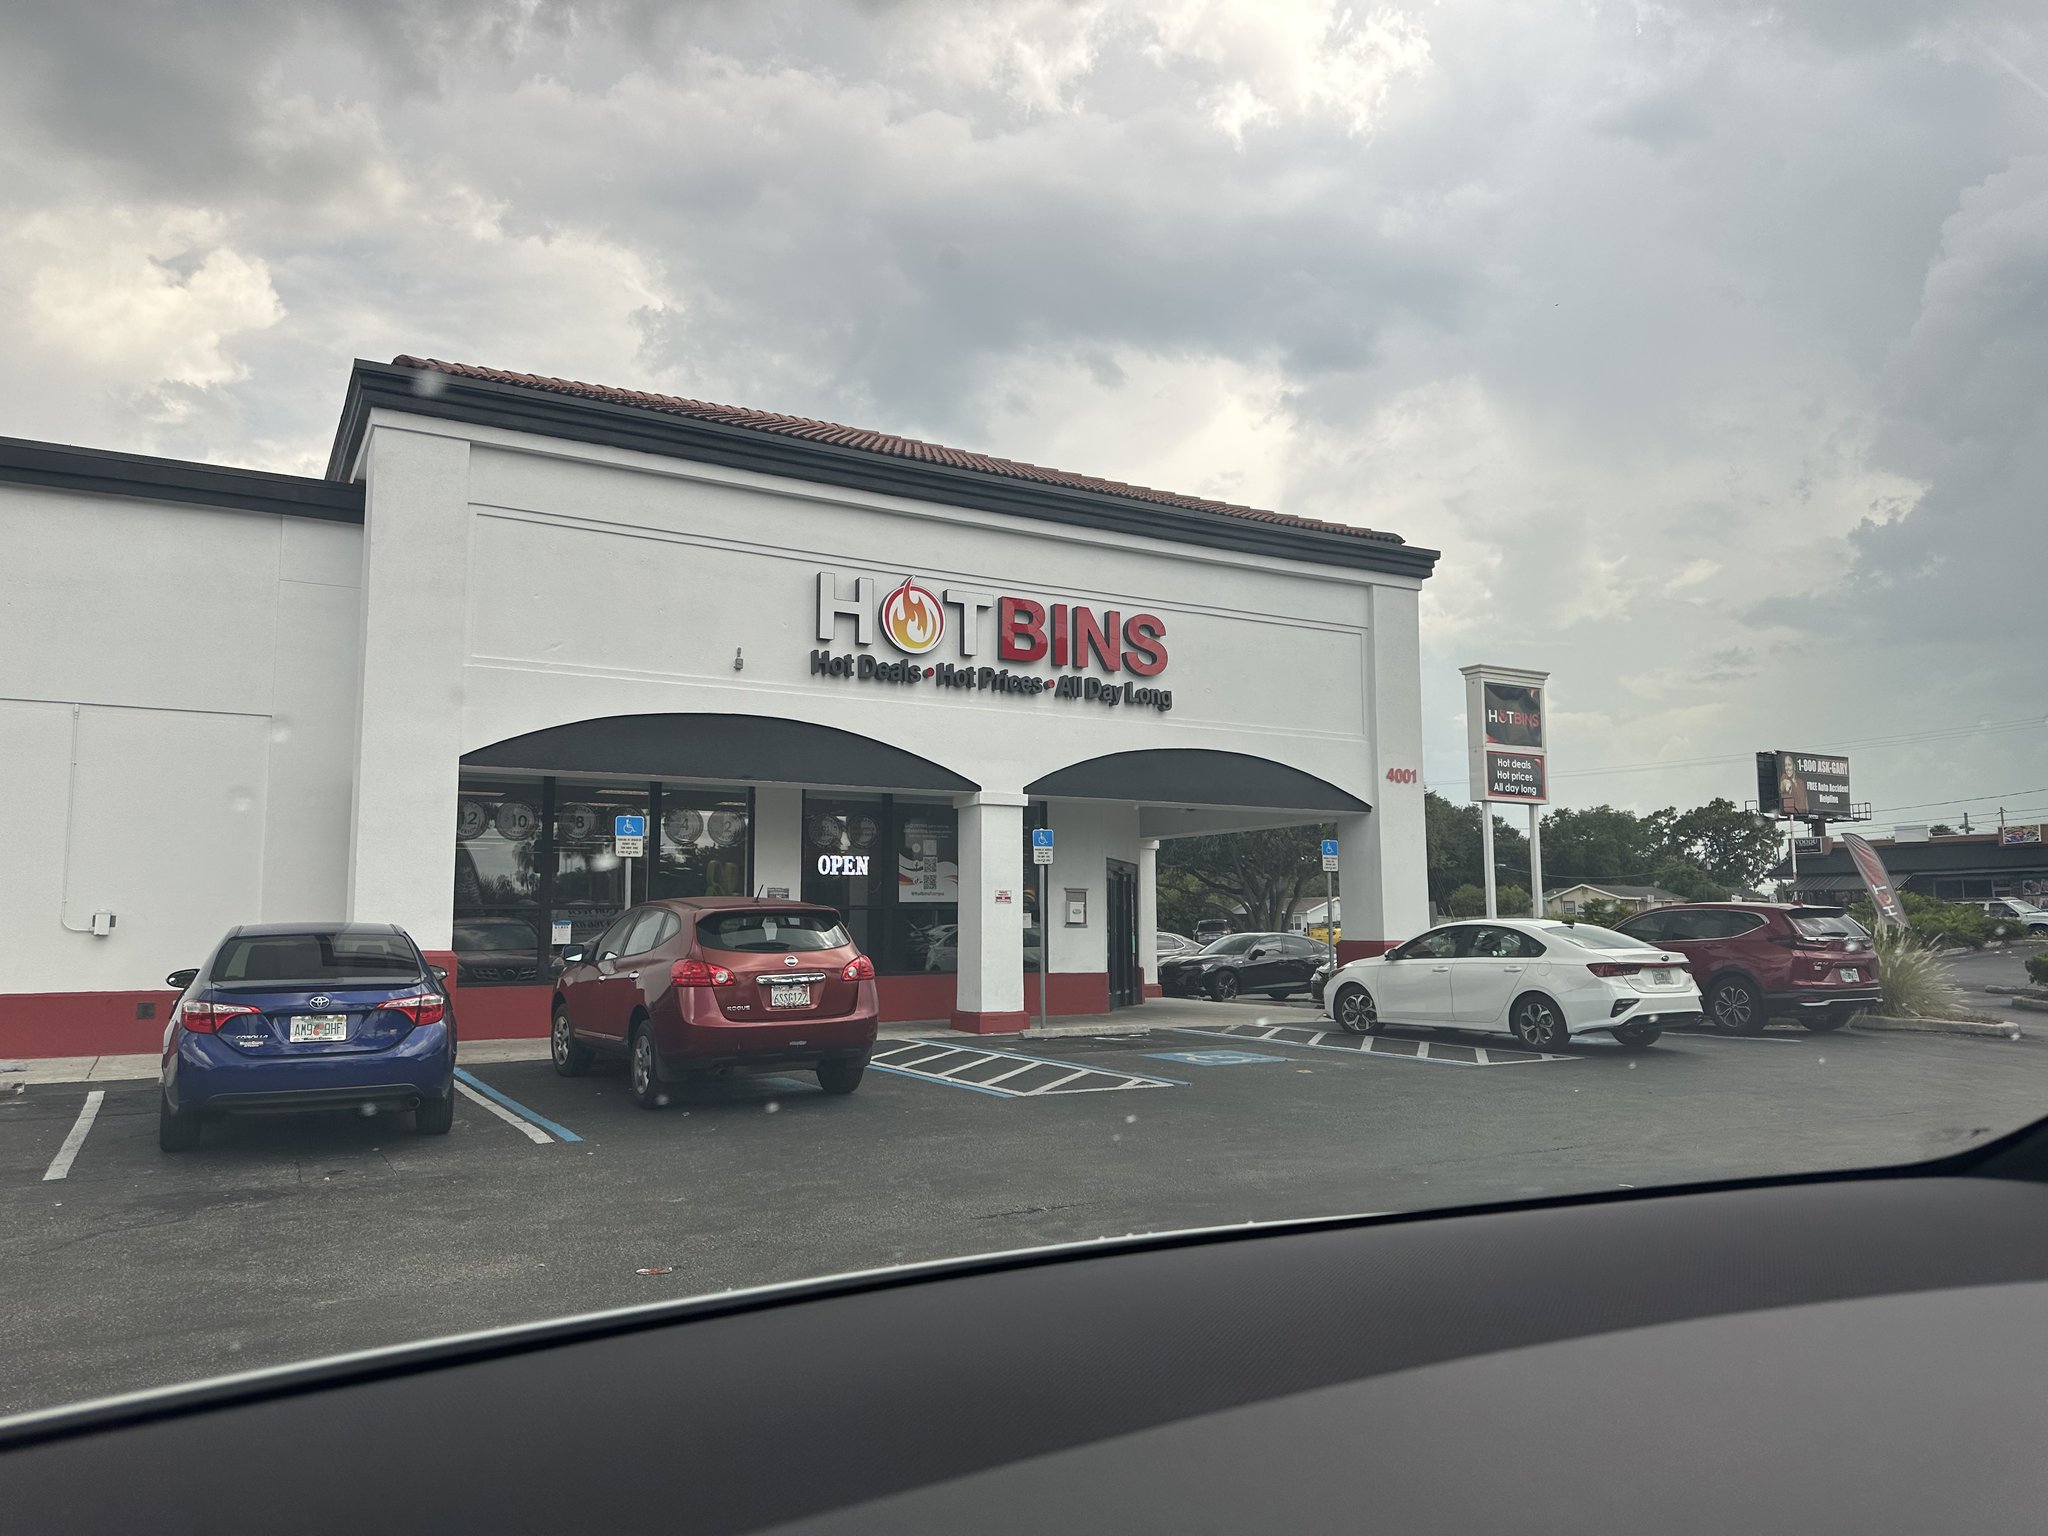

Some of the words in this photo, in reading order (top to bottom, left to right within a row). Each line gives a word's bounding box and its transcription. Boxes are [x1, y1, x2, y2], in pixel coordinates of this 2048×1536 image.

[810, 650, 854, 677] Hot
[857, 654, 921, 683] Deals
[935, 662, 976, 689] Hot
[978, 667, 1043, 693] Prices
[1054, 675, 1083, 698] All
[1084, 677, 1123, 706] Day
[1124, 681, 1172, 711] Long
[1497, 758, 1510, 768] Hot
[1511, 759, 1532, 769] deals
[1797, 758, 1817, 772] 1-800
[1817, 760, 1848, 775] ASK-GARY
[1386, 768, 1417, 784] 4001
[1496, 770, 1510, 780] Hot
[1511, 771, 1534, 782] prices
[1493, 782, 1504, 792] All
[1504, 783, 1520, 795] day
[1520, 784, 1537, 796] long
[818, 854, 870, 876] OPEN
